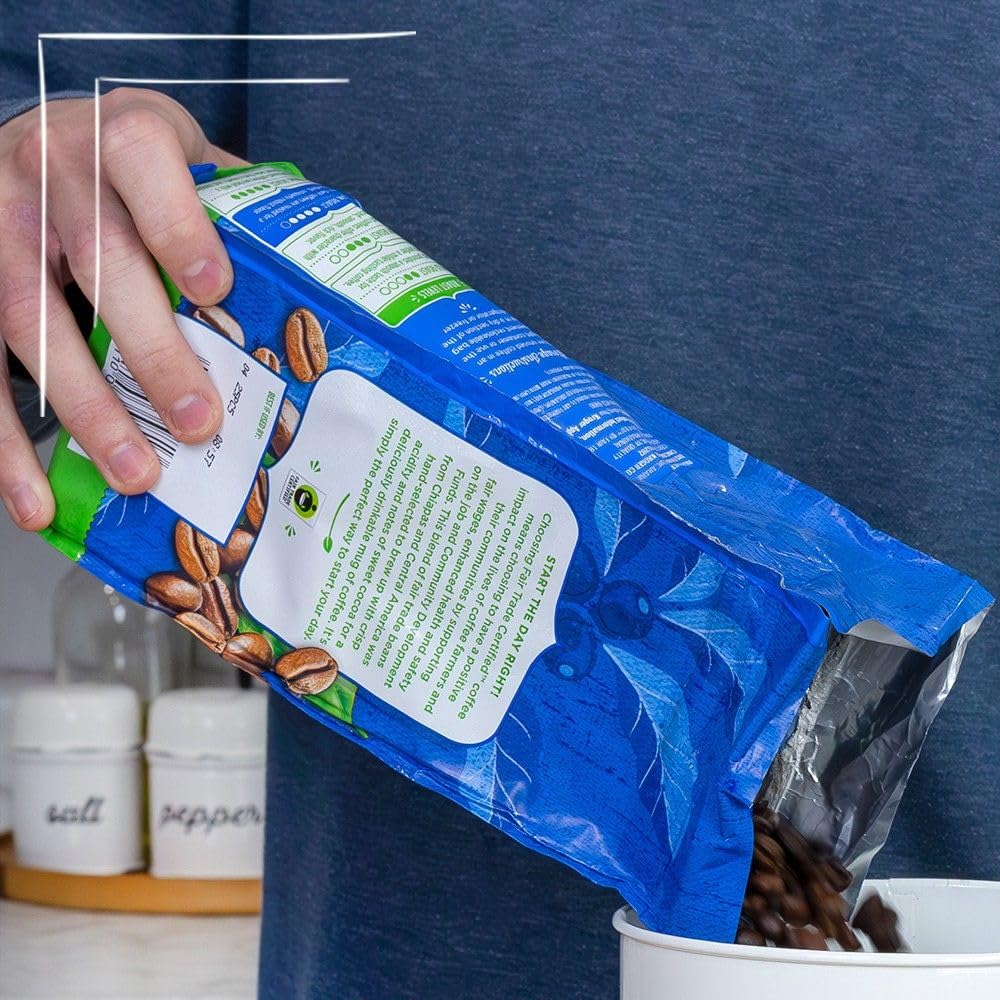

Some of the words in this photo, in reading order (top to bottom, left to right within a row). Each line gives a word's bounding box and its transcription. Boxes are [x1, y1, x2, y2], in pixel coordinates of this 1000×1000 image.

[342, 272, 365, 288] coffee.
[356, 282, 370, 290] for
[415, 284, 444, 299] LEVELS
[440, 318, 470, 334] freezer
[456, 331, 465, 340] of
[440, 336, 457, 348] the
[449, 342, 471, 355] bag
[460, 352, 476, 363] the
[475, 357, 489, 366] an
[487, 352, 543, 378] Instructions
[262, 405, 271, 414] IF
[265, 390, 276, 408] BEST
[254, 427, 264, 441] BY:
[258, 412, 269, 430] USED
[577, 413, 602, 429] Kroger
[202, 433, 224, 468] 08:57
[375, 417, 399, 458] simply
[368, 458, 383, 478] the
[380, 427, 411, 491] deliciously
[399, 439, 423, 481] acidity
[435, 454, 455, 482] from
[633, 453, 657, 470] KROGER
[291, 475, 300, 490] FAIR
[443, 468, 467, 505] Funds.
[470, 465, 482, 481] on
[281, 474, 295, 502] CERTIFIED
[285, 489, 295, 506] TRADE
[352, 478, 373, 522] perfect
[392, 480, 407, 505] and
[399, 453, 437, 534] hand-selected
[463, 481, 479, 501] the
[482, 477, 498, 499] fair
[359, 490, 387, 543] drinkable
[381, 503, 398, 535] notes
[416, 483, 443, 528] Chiapas
[453, 499, 471, 522] job
[466, 498, 488, 535] wages,
[488, 501, 506, 530] their
[506, 486, 529, 527] impact
[434, 508, 452, 531] This
[514, 512, 535, 551] means
[342, 522, 358, 546] way
[376, 536, 388, 551] of
[394, 533, 407, 547] to
[410, 527, 424, 552] and
[447, 521, 464, 546] and
[499, 527, 511, 543] on
[523, 512, 552, 566] Choosing
[337, 546, 350, 560] to
[349, 542, 367, 570] mug
[421, 531, 443, 566] blend
[490, 544, 507, 566] the
[324, 560, 342, 589] start
[362, 549, 381, 585] sweet
[383, 547, 402, 578] brew
[393, 552, 416, 594] Central
[416, 565, 426, 581] of
[444, 538, 473, 595] enhanced
[458, 529, 494, 602] communities
[535, 554, 556, 596] START
[345, 570, 356, 586] of
[375, 577, 388, 594] up
[408, 579, 423, 600] fair
[420, 544, 454, 611] Community
[480, 564, 499, 591] lives
[492, 551, 519, 603] choosing
[516, 566, 532, 590] Fair
[313, 588, 330, 618] your
[327, 585, 350, 623] coffee.
[347, 584, 367, 620] cocoa
[363, 595, 380, 621] with
[429, 593, 452, 630] health
[451, 602, 466, 619] by
[474, 592, 485, 608] of
[487, 603, 500, 617] to
[502, 591, 523, 623] Trade
[522, 597, 541, 624] THE
[303, 618, 319, 640] day.
[371, 592, 399, 642] America
[391, 600, 414, 632] trade
[458, 606, 479, 643] coffee
[335, 639, 344, 648] a
[339, 621, 354, 640] for
[351, 622, 368, 651] crisp
[417, 629, 434, 656] and
[475, 617, 494, 647] have
[511, 623, 529, 653] DAY
[361, 643, 377, 667] was
[376, 632, 399, 669] beans
[383, 610, 427, 689] Development
[419, 615, 457, 683] supporting
[469, 646, 479, 655] a
[398, 655, 421, 693] safety
[436, 643, 465, 689] farmers
[447, 654, 475, 702] positive
[489, 652, 517, 698] RIGHT!
[423, 689, 440, 715] and
[457, 680, 483, 720] coffee
